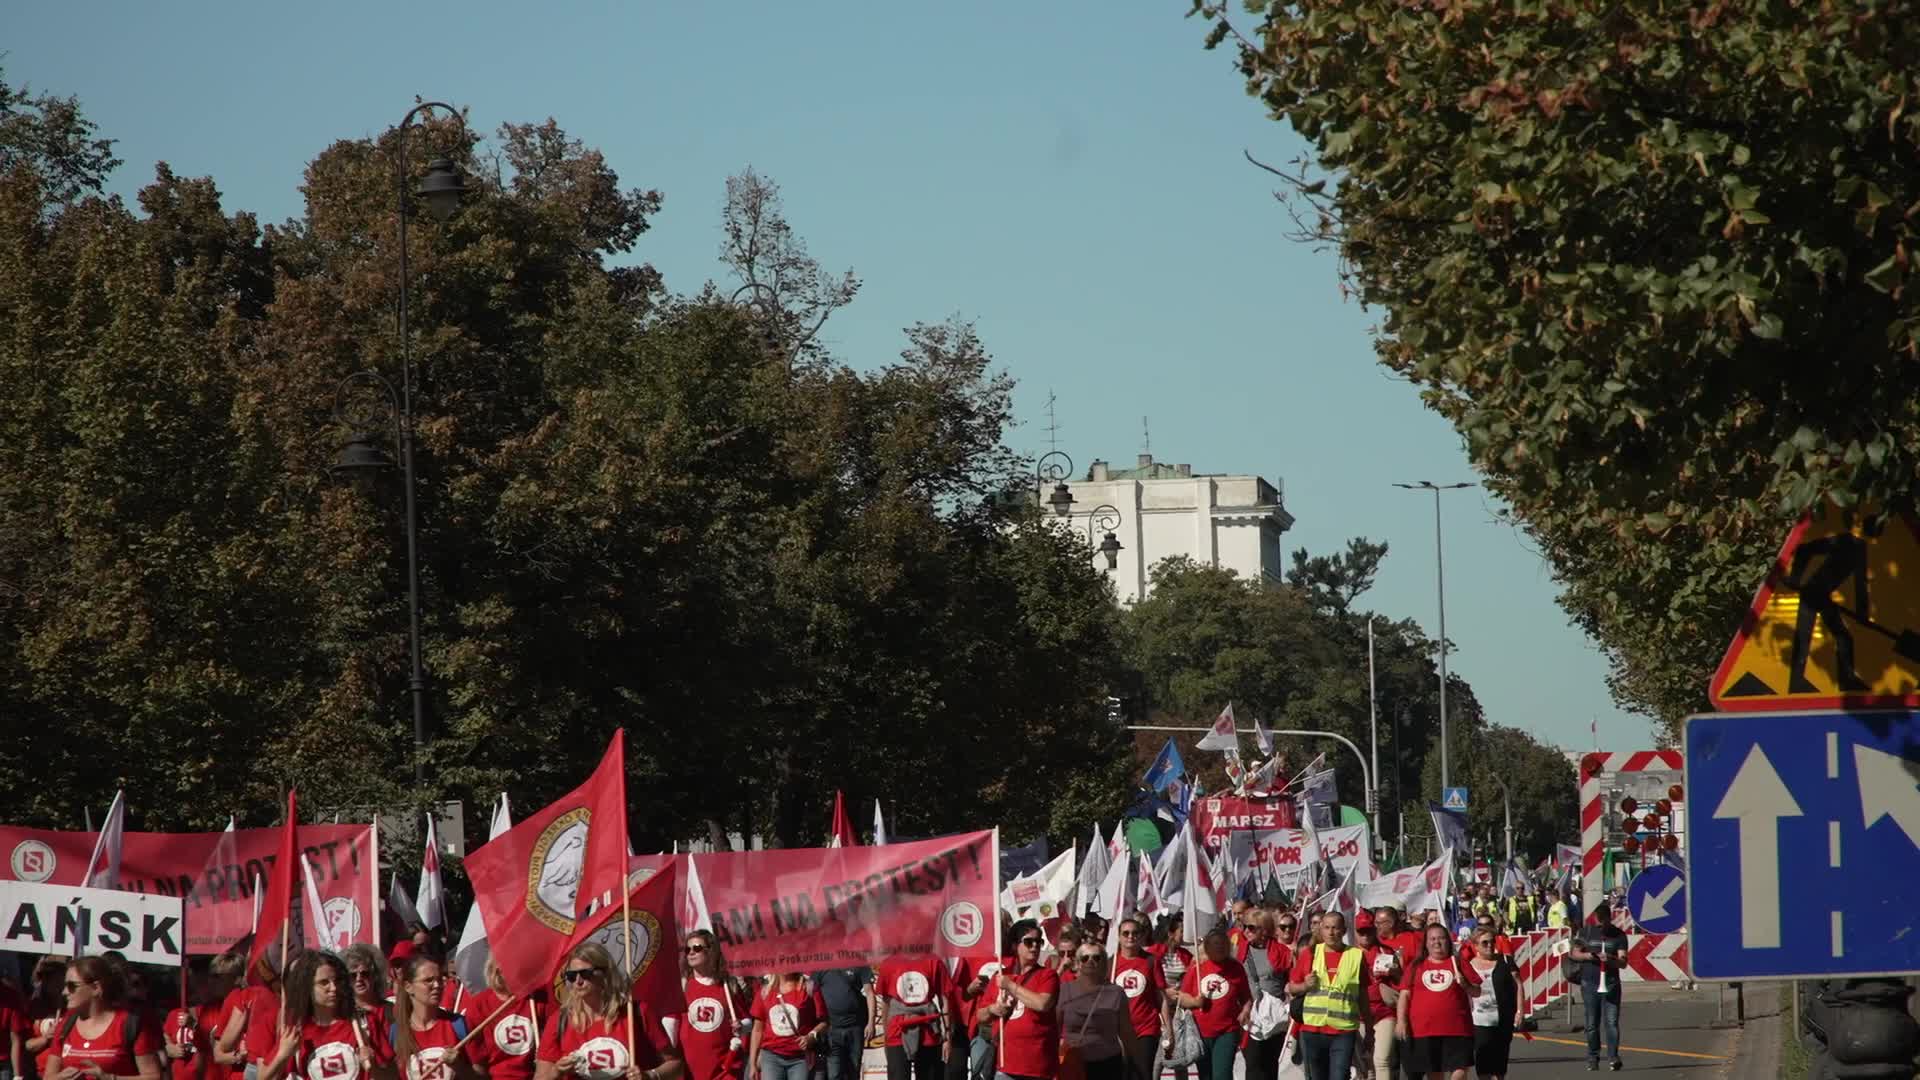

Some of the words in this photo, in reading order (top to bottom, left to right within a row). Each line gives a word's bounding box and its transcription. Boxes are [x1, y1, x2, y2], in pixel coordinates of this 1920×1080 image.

[1213, 814, 1276, 828] MARSZ
[769, 892, 822, 936] NA
[822, 849, 960, 921] PROTEST
[967, 842, 983, 880] !
